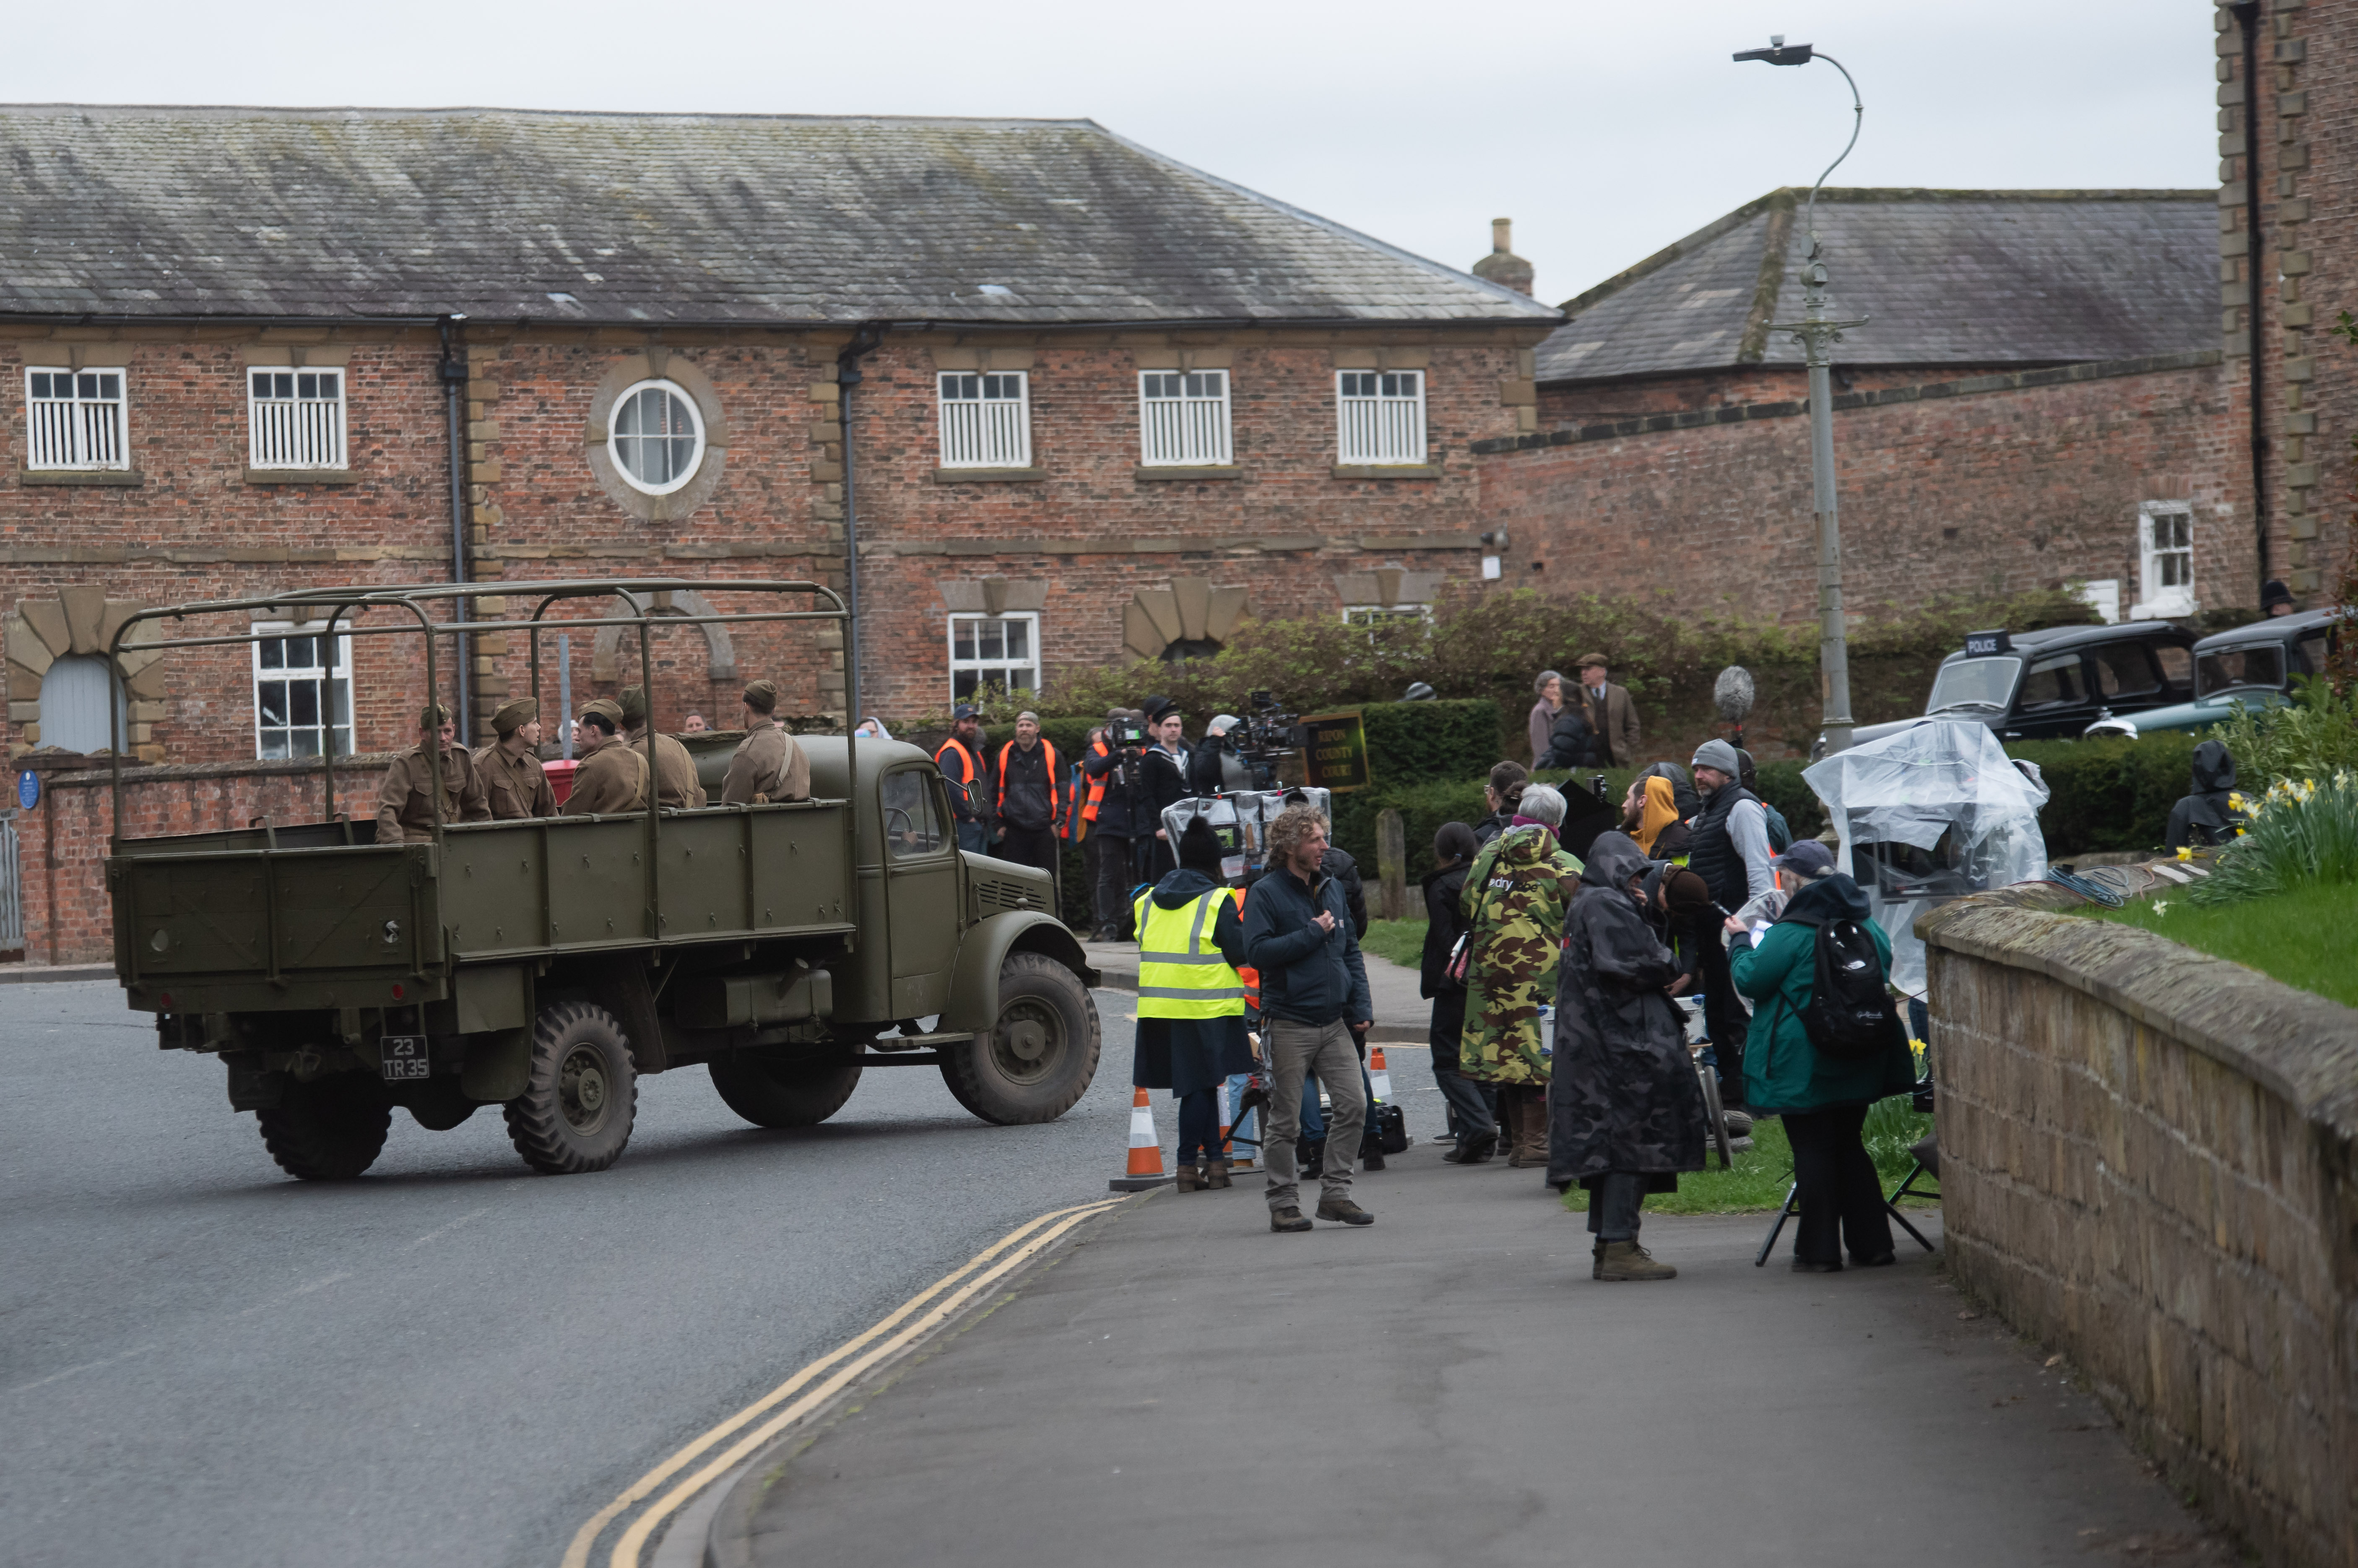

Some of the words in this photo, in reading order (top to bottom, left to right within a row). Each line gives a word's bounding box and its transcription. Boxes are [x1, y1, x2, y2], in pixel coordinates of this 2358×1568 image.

[1968, 638, 1997, 653] POLICE
[1315, 746, 1352, 761] COUNTY
[1321, 764, 1352, 779] COURT
[1495, 877, 1538, 893] drybe
[393, 1038, 414, 1056] 23
[384, 1059, 404, 1077] TR
[407, 1059, 428, 1076] 35
